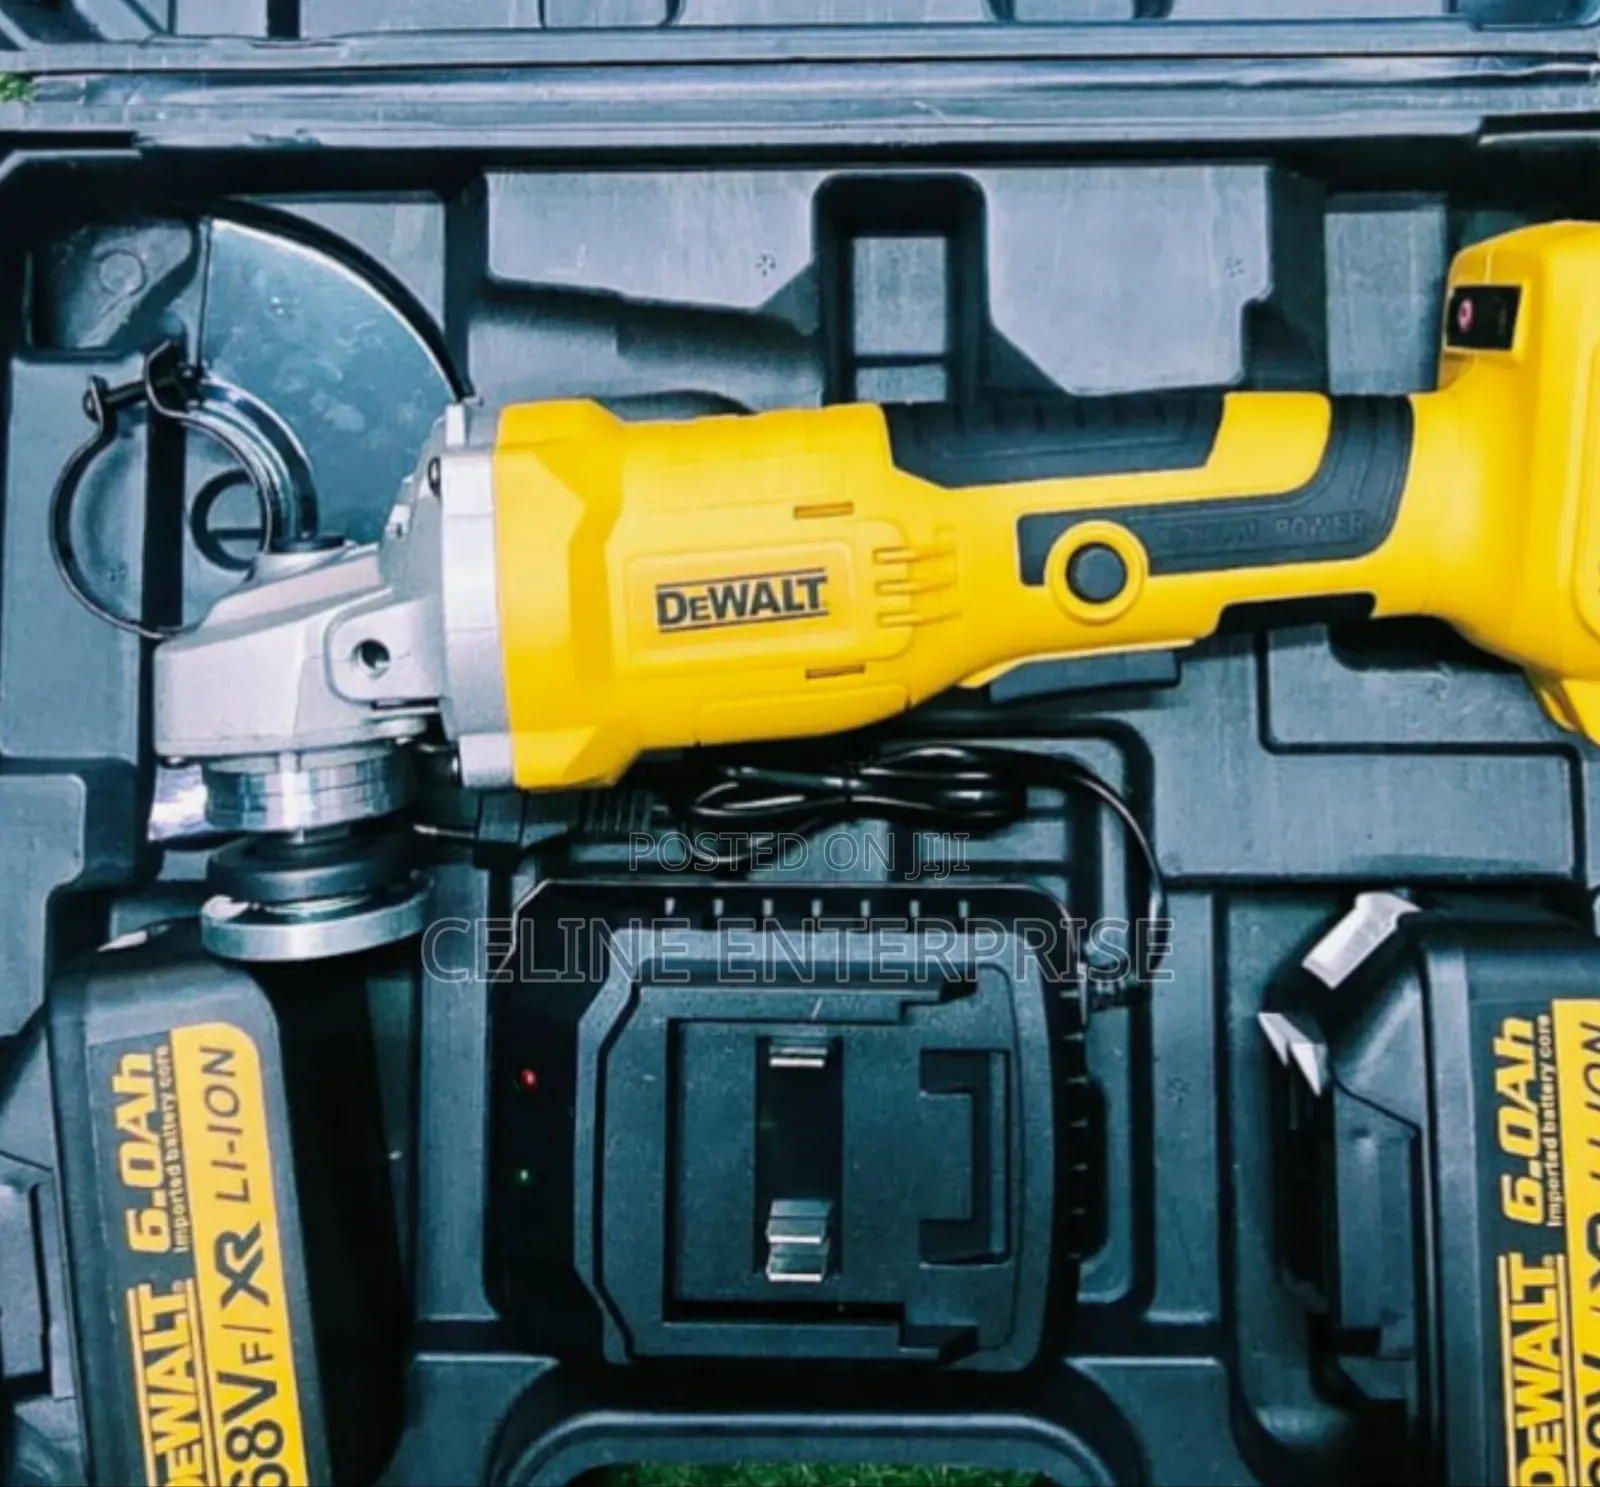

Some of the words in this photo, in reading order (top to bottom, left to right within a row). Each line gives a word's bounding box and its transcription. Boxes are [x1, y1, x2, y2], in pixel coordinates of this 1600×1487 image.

[1536, 1014, 1553, 1058] core
[160, 1092, 181, 1162] battery
[198, 1045, 251, 1204] LI-ION
[1492, 1017, 1546, 1225] 6.0Ah
[1538, 1062, 1559, 1133] battery
[112, 1053, 171, 1253] 6.0Ah
[1543, 1136, 1564, 1227] Imported
[165, 1164, 192, 1254] Imported
[213, 1220, 270, 1311] XR
